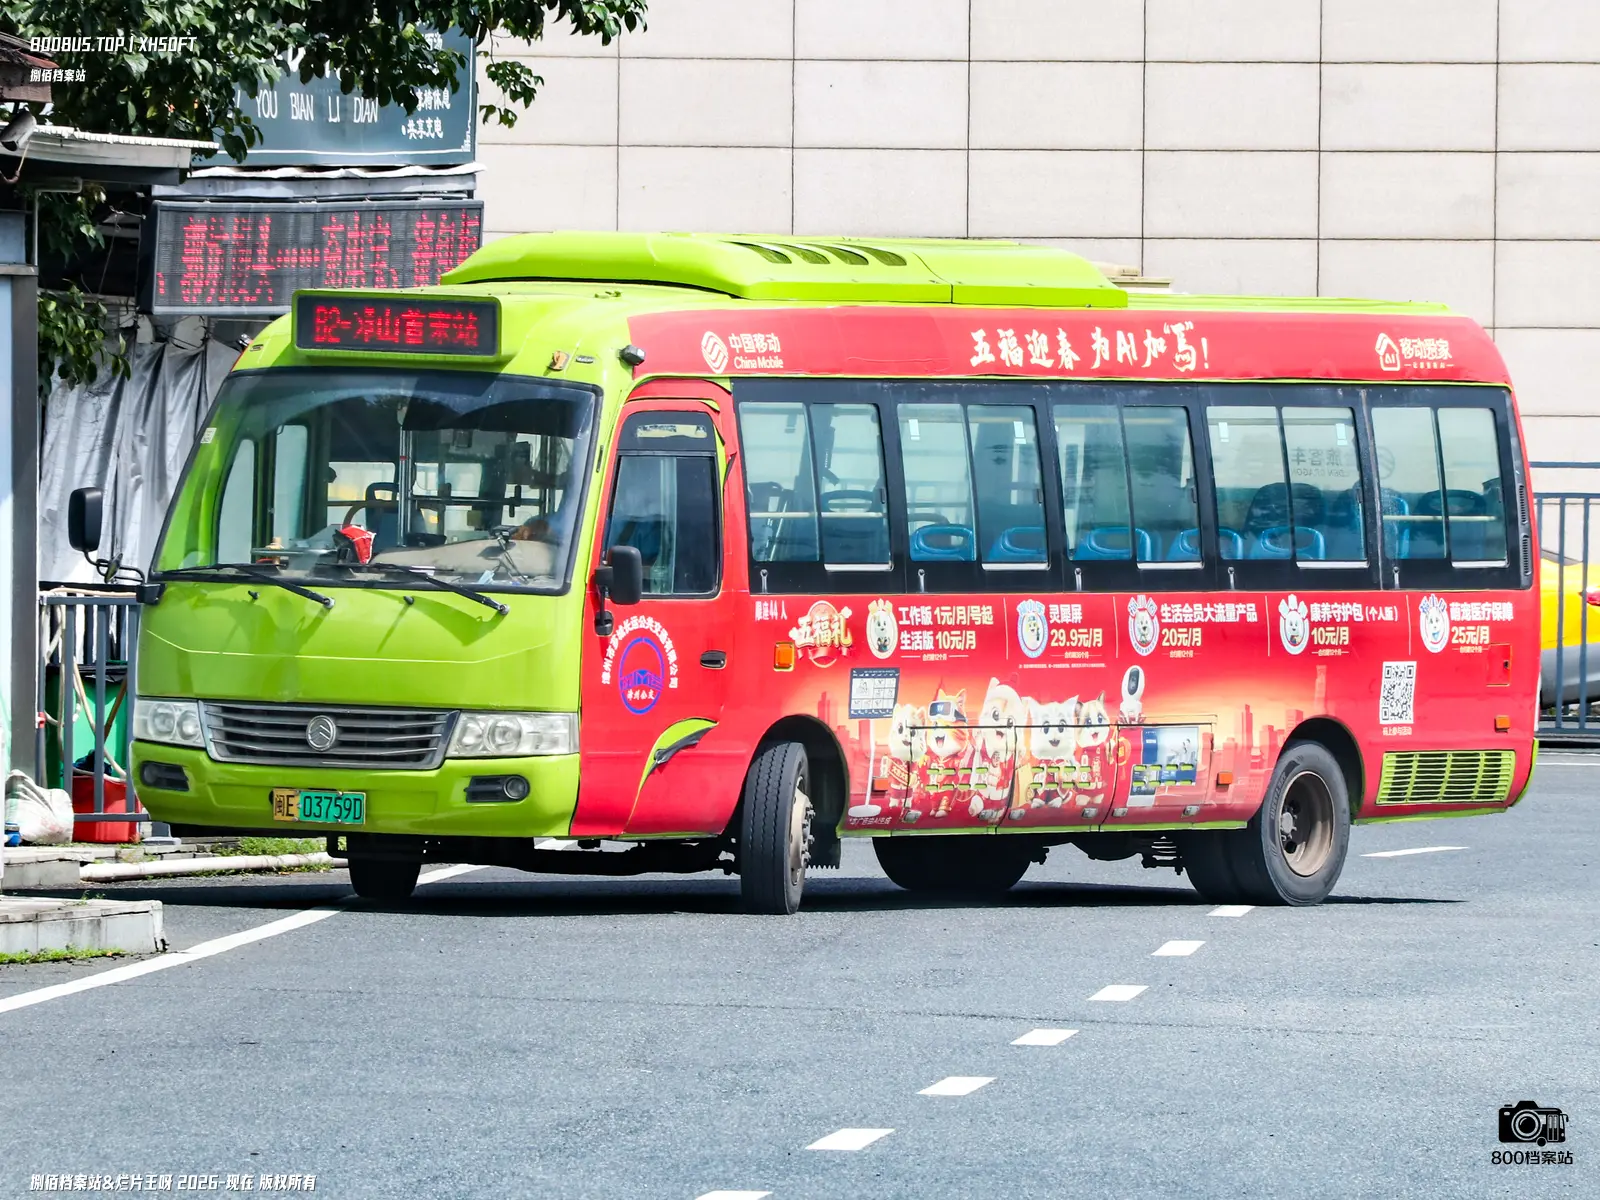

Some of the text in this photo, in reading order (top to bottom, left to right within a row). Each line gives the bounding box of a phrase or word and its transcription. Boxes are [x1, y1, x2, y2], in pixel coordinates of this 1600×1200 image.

[255, 89, 278, 119] YOU
[290, 92, 314, 121] BIAN
[328, 96, 341, 123] LI
[353, 96, 379, 123] DIAN
[728, 332, 781, 353] 中国移动
[969, 327, 1081, 371] 五福迎春
[733, 356, 783, 369] China Mobile
[898, 606, 933, 626] 工作版
[934, 605, 994, 626] 1元/月/号起
[1160, 603, 1258, 623] 生活会员大流量产品
[1449, 602, 1514, 621] 萌宠医疗保障
[795, 613, 853, 648] 五福礼
[900, 630, 977, 651] 生活版 10元/月
[1050, 628, 1103, 648] 29.9元/月
[1161, 627, 1202, 647] 20元/月
[1311, 626, 1349, 645] 10元/月
[1451, 625, 1490, 645] 25元/月
